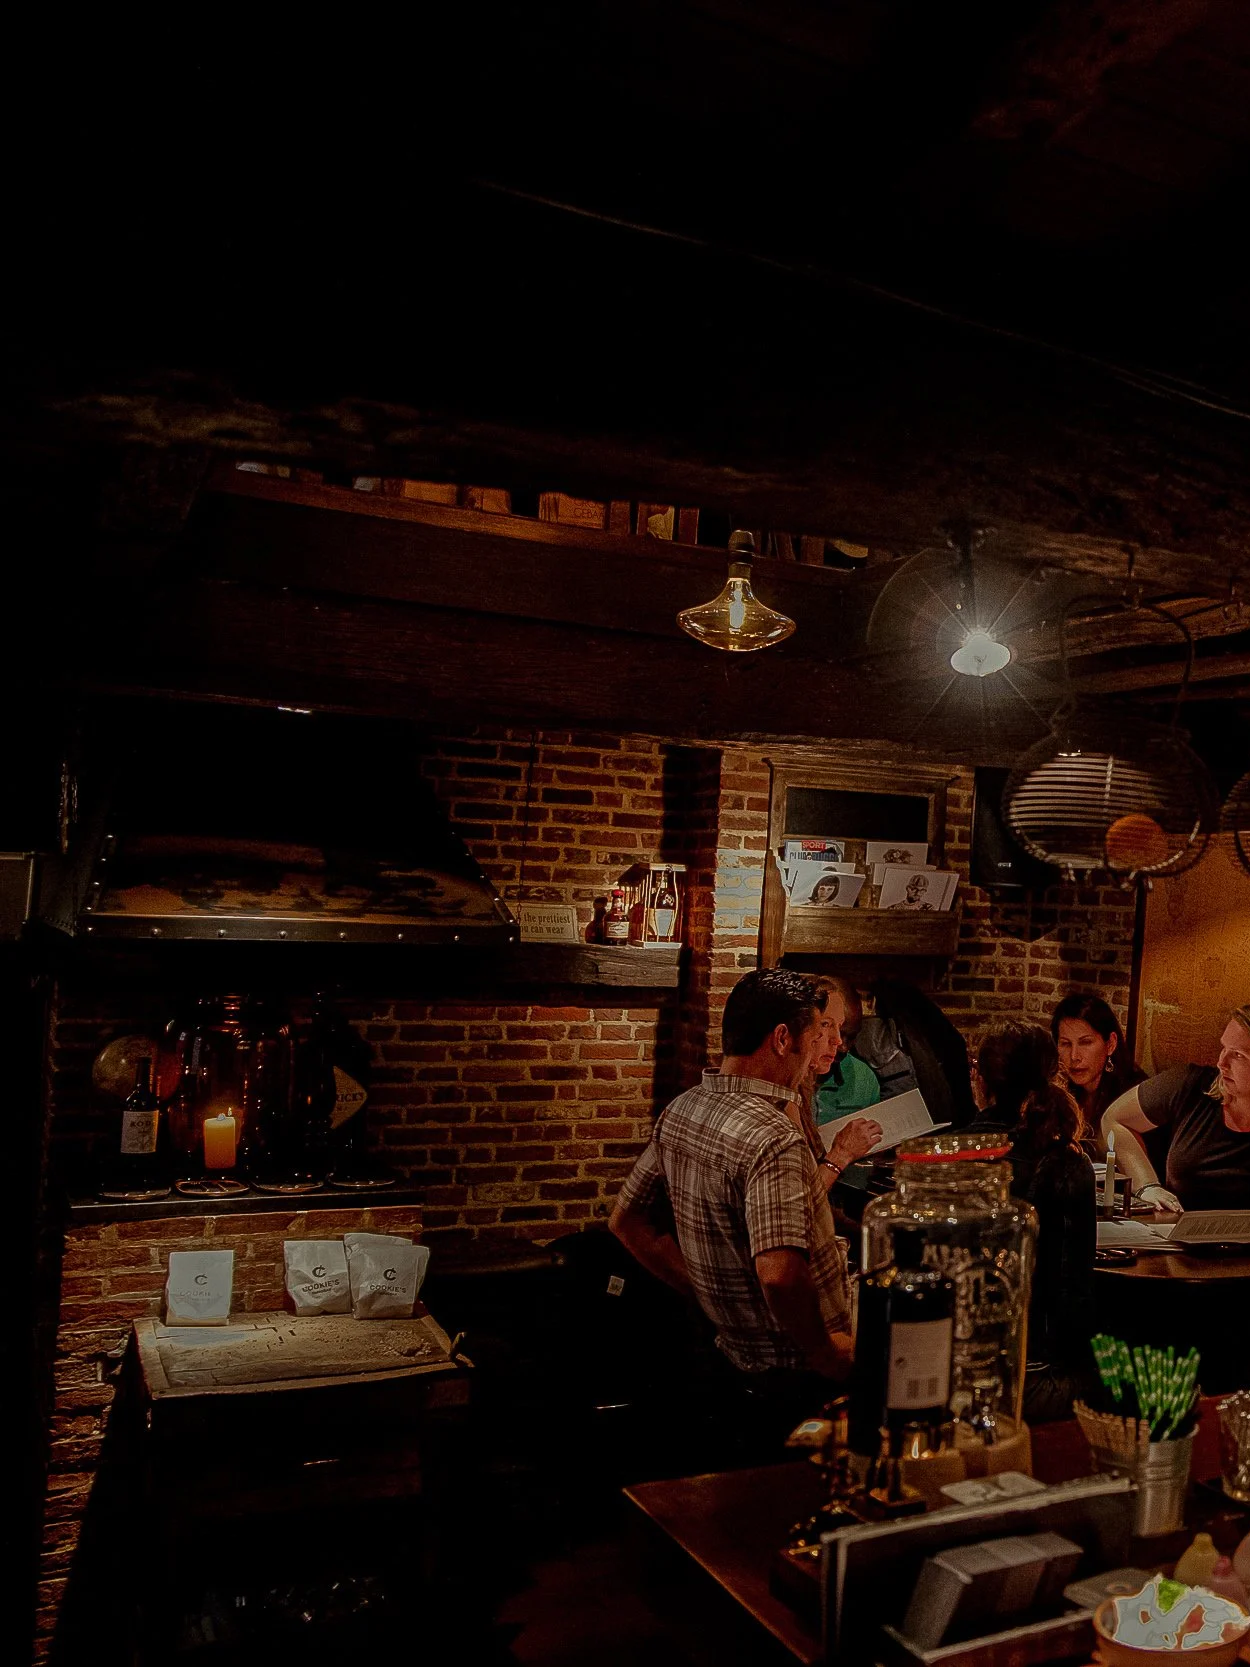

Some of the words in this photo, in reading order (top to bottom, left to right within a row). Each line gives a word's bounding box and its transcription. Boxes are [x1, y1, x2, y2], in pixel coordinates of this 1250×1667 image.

[802, 841, 826, 849] SPORT
[524, 912, 536, 923] the
[538, 912, 571, 925] prettiest
[519, 924, 529, 933] ou
[530, 925, 544, 934] can
[546, 926, 564, 934] wear
[302, 1279, 340, 1292] COOKIE'S
[370, 1285, 407, 1293] COOKIE'S
